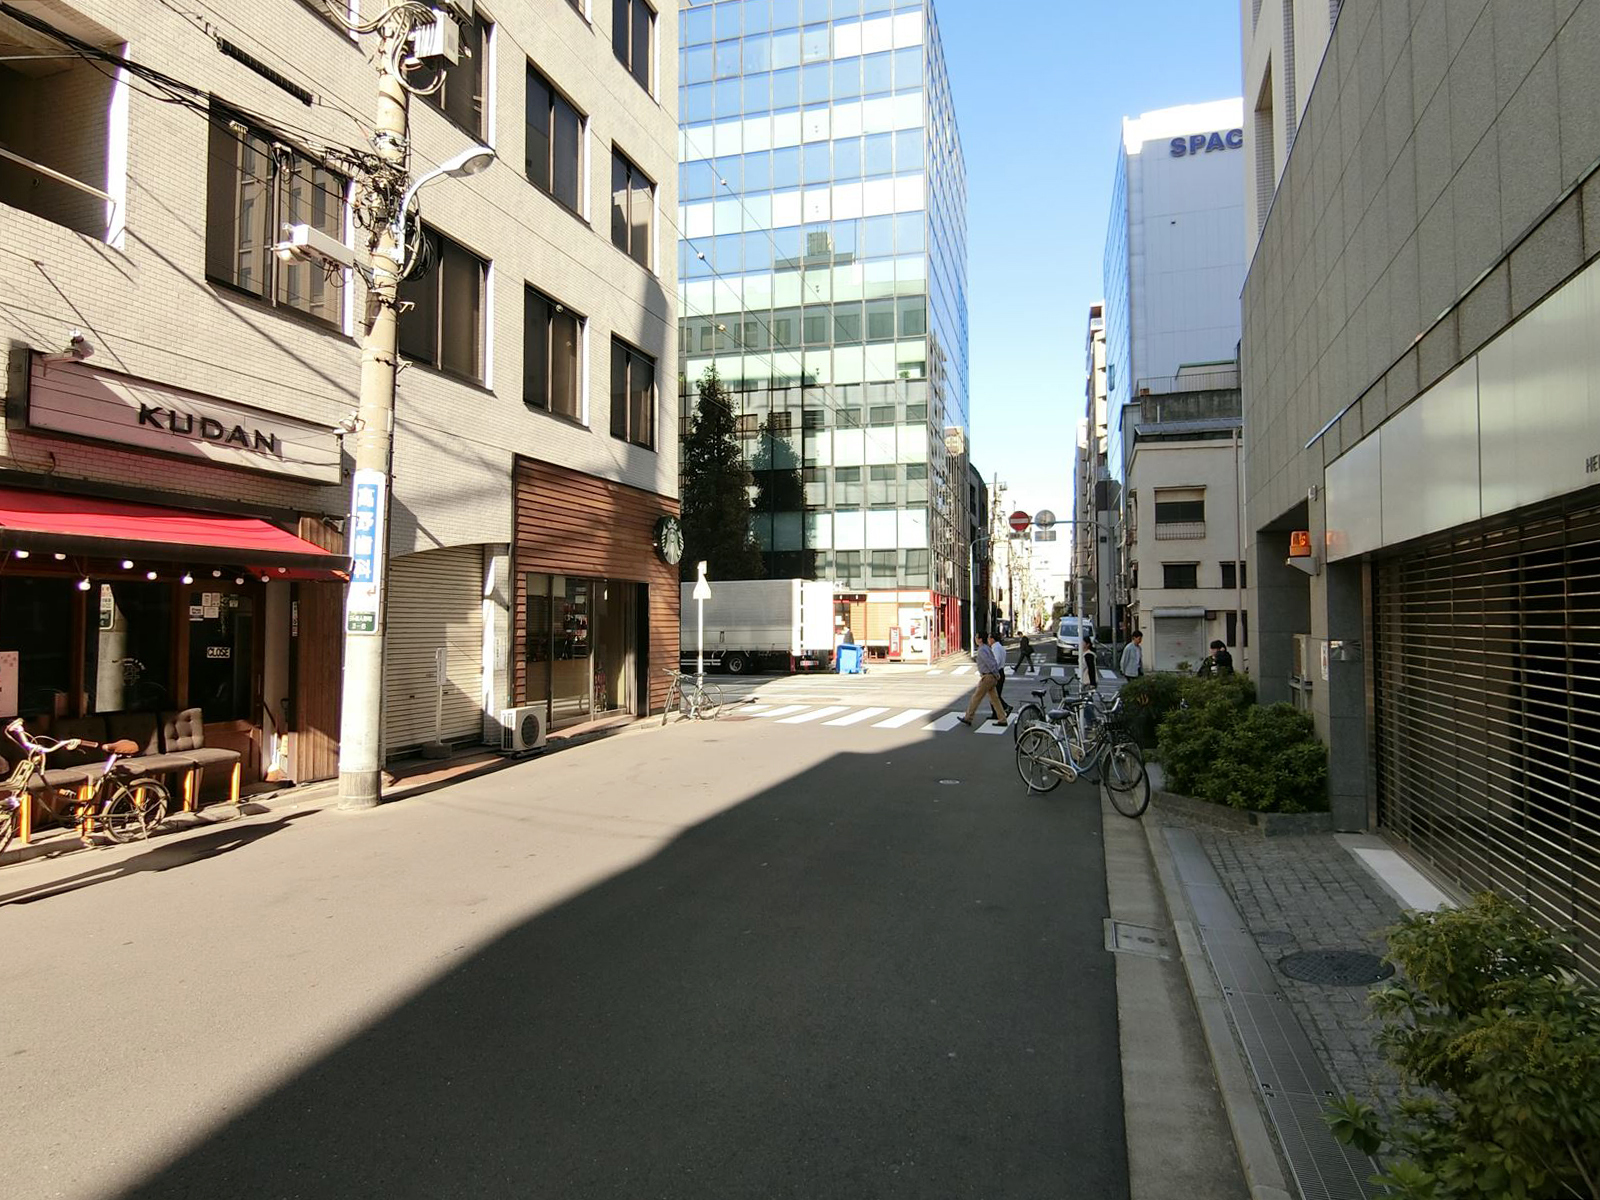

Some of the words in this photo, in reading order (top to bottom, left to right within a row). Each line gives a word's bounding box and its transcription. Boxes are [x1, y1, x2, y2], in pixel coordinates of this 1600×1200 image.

[1170, 128, 1243, 158] SPAC
[138, 404, 278, 454] KUDAN
[207, 647, 229, 657] CLOSE
